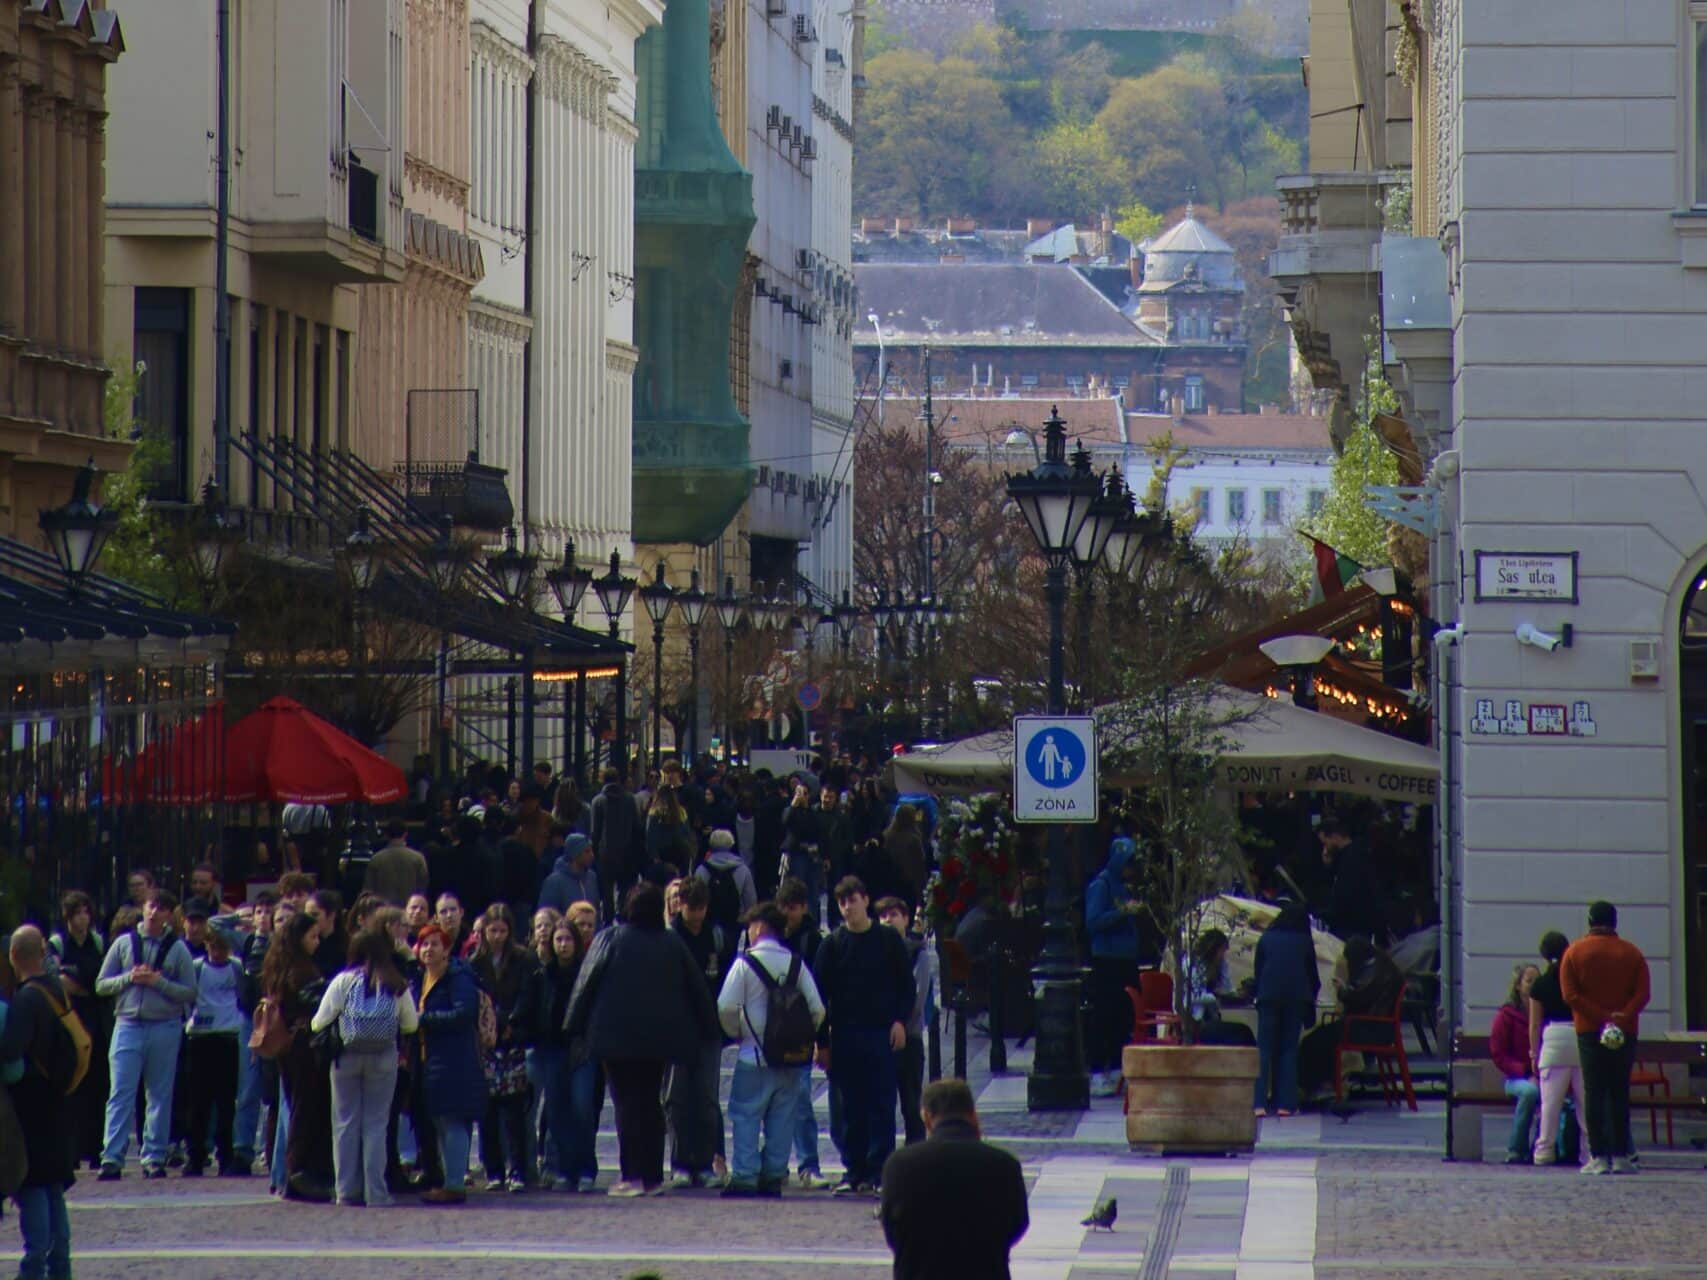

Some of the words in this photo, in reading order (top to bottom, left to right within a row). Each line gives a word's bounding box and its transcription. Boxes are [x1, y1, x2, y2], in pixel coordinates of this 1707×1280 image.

[1498, 567, 1520, 584] Sas
[1528, 568, 1555, 585] utca
[1226, 765, 1281, 785] DONUT
[1378, 773, 1437, 795] COFFEE
